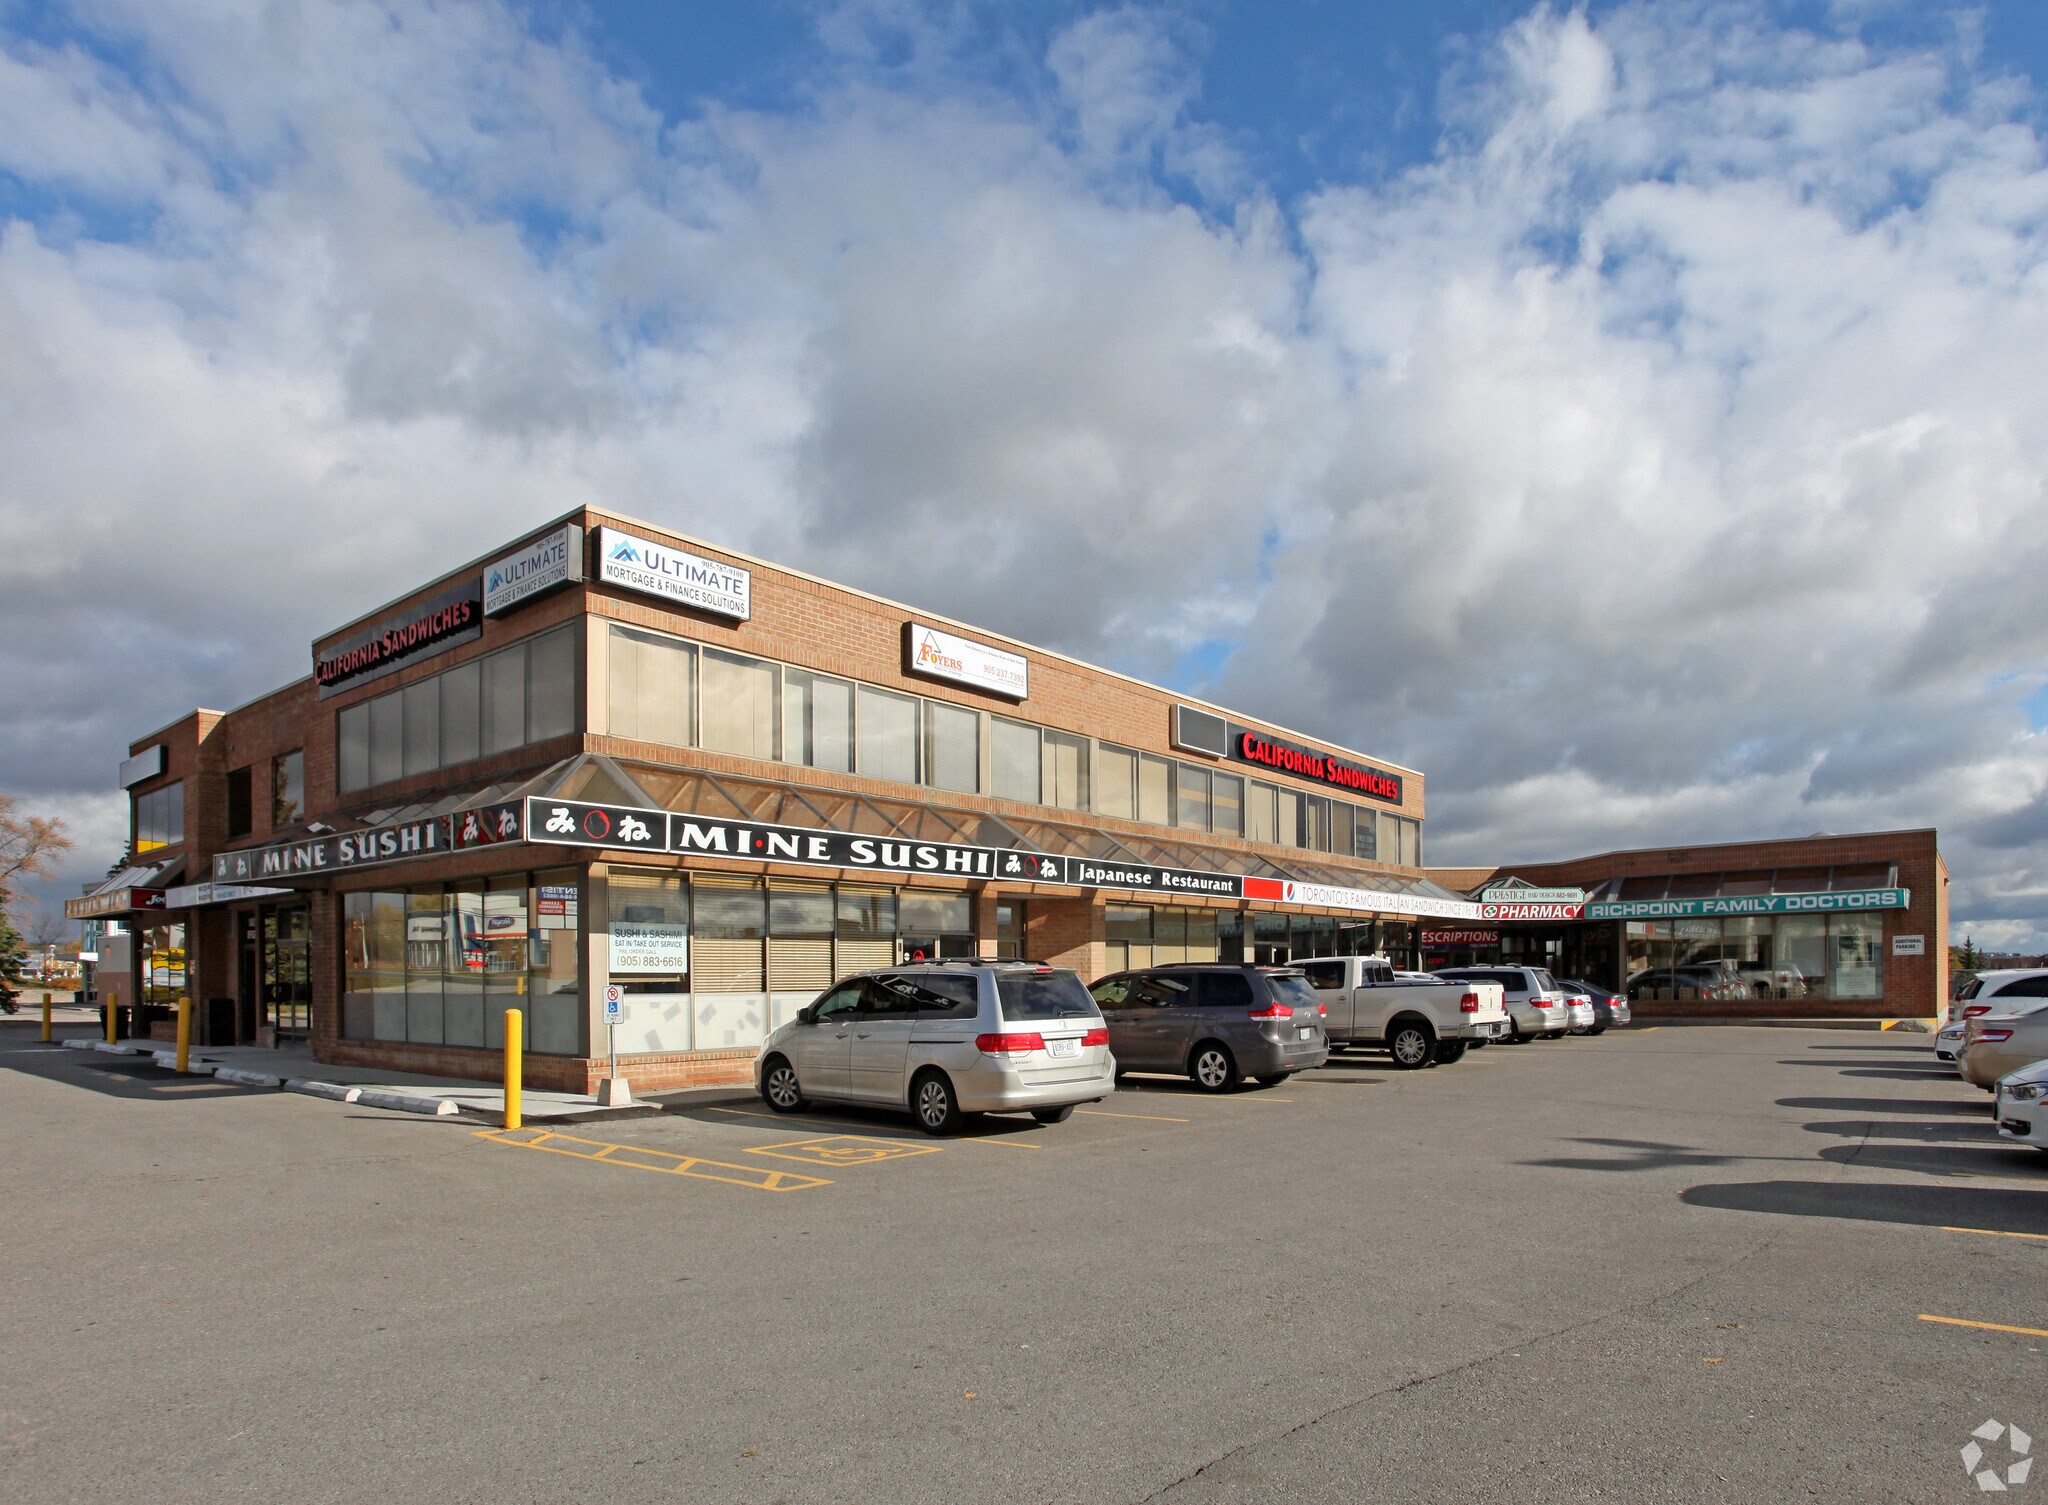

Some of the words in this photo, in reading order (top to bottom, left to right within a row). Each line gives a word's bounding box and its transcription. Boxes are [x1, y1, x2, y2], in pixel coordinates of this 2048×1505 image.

[505, 542, 565, 584] ULTIMATE
[645, 550, 743, 596] ULTIMATE
[486, 591, 511, 611] MORTGAGE
[517, 579, 537, 597] FINANCE
[538, 566, 566, 588] SOLUTIONS
[606, 565, 655, 588] MORTGAGE
[657, 581, 663, 590] &
[665, 583, 700, 601] FINANCE
[701, 592, 745, 614] SOLUTIONS
[314, 641, 379, 685] CALIFORNIA
[382, 599, 471, 656] SANDWICHES
[920, 643, 963, 671] FOYERS
[1242, 731, 1325, 779] CALIFORNIA
[1326, 757, 1398, 799] SANDWICHES
[339, 823, 437, 862] SUSHI
[849, 840, 991, 874] SUSHI
[1078, 862, 1152, 887] Japanese
[1161, 872, 1233, 893] Restaurant
[1302, 886, 1349, 904] TORONTO'S
[1351, 892, 1382, 908] FAMOUS
[1384, 896, 1409, 910] ITALIAN
[1411, 900, 1444, 914] SANDWICH
[1445, 903, 1461, 915] SINCE
[1488, 890, 1527, 900] PRESTIGE
[1591, 901, 1696, 917] RICHPOINT
[1702, 898, 1779, 913] FAMILY
[1785, 892, 1897, 909] DOCTORS
[1499, 905, 1583, 918] PHARMACY
[615, 928, 640, 938] SUSHI
[642, 930, 648, 938] &
[1409, 931, 1498, 943] ESCRIPTIONS
[617, 956, 641, 966] (905)
[643, 956, 683, 967] 883-6616
